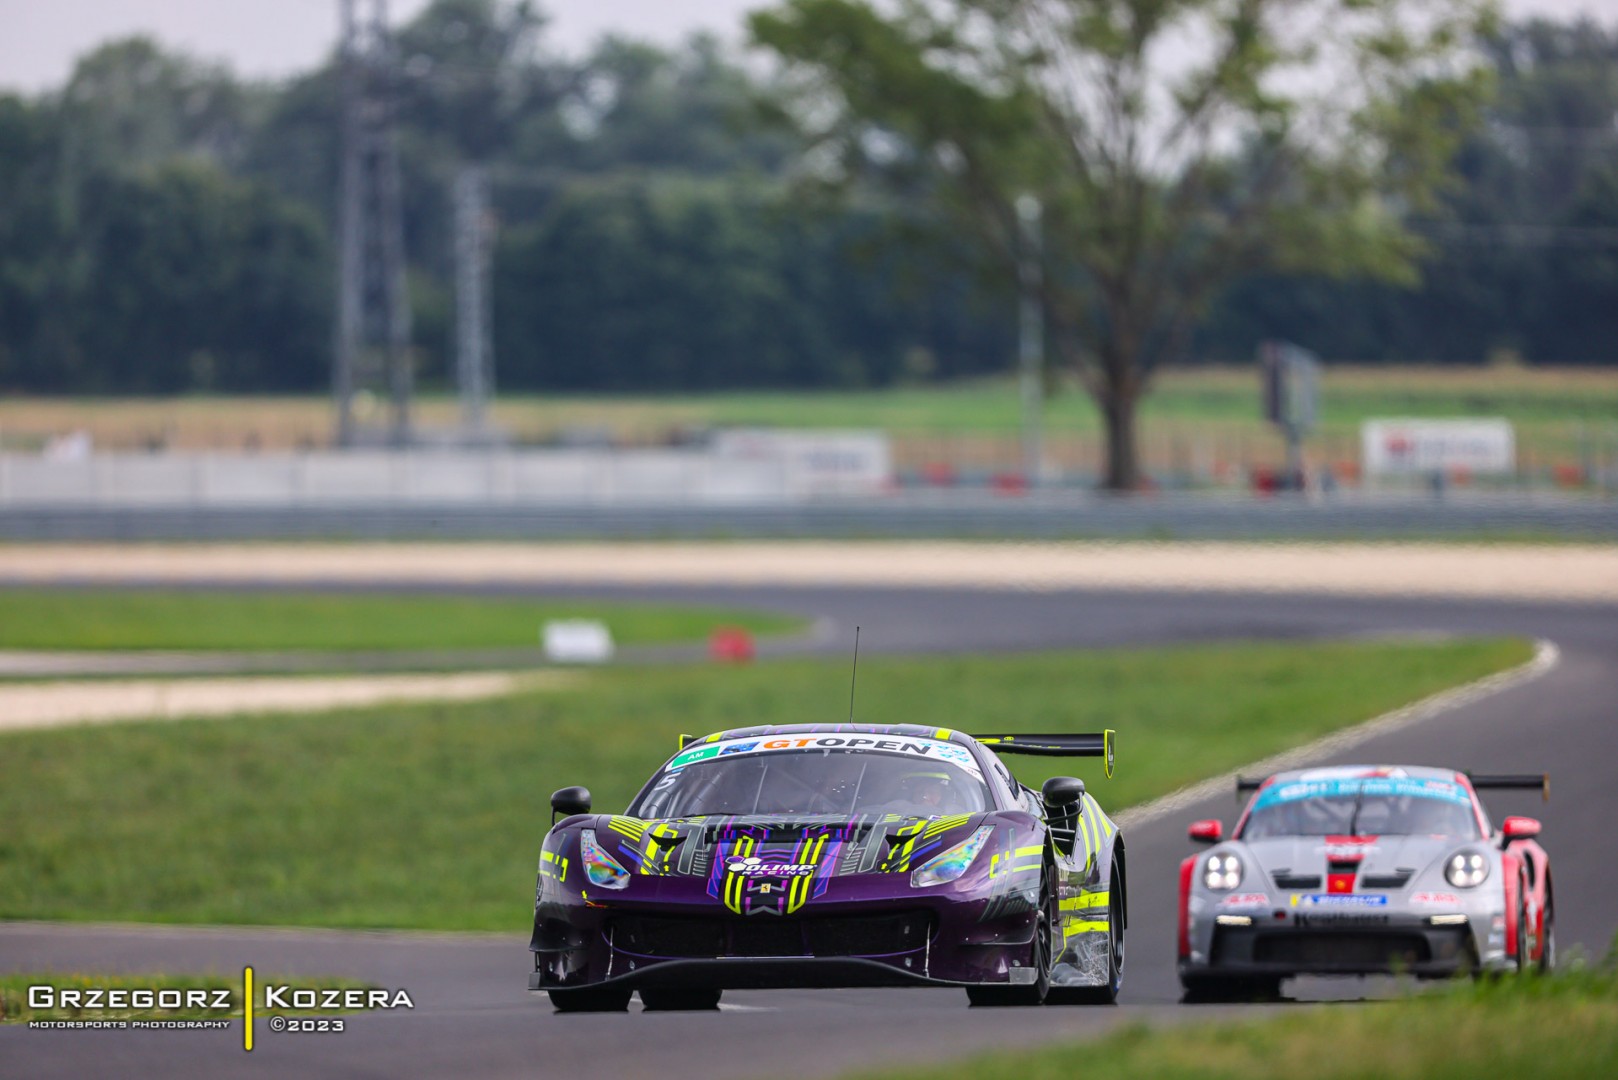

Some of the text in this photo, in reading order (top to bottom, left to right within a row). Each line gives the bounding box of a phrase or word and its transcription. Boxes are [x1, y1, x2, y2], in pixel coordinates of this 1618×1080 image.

[687, 751, 705, 761] AM
[654, 772, 682, 791] 5
[745, 863, 814, 872] OLIMP
